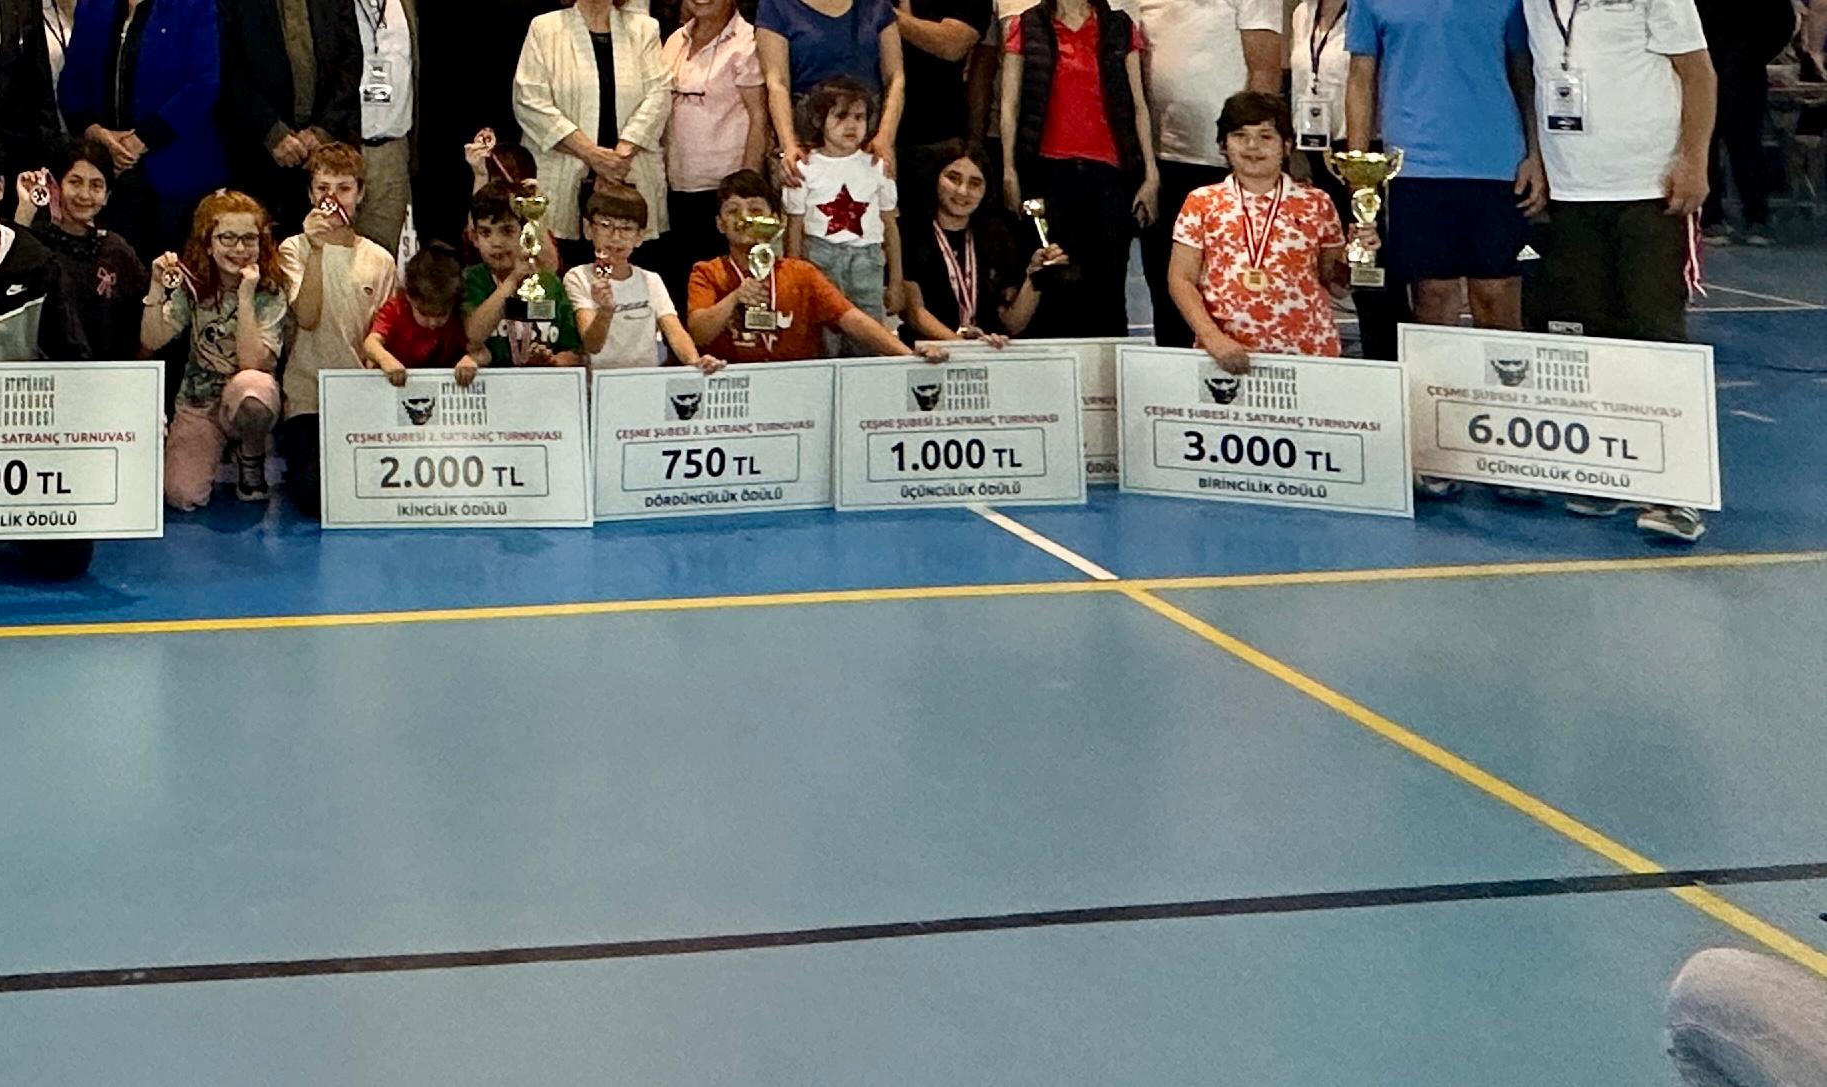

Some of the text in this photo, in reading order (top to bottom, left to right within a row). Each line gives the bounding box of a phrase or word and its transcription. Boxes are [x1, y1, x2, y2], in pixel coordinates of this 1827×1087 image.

[1427, 385, 1469, 399] ÇEŞME
[1246, 413, 1304, 427] SATRANÇ
[2, 433, 60, 445] SATRANÇ
[64, 432, 135, 443] TURNUVASI
[1468, 414, 1638, 460] 6.000 TL
[891, 439, 1022, 471] 1.000 TL
[1183, 430, 1341, 472] 3.000 TL
[380, 456, 524, 488] 2.000 TL
[662, 447, 761, 479] 750 TL
[1476, 459, 1630, 488] ÜÇÜNCÜLÜK ÖDÜLÜ
[37, 471, 70, 494] TL
[901, 481, 1021, 499] ÜÇÜNCÜLÜK ÖDÜLÜ
[1198, 476, 1327, 498] BİRİNCİLİK ÖDÜLÜ
[397, 501, 507, 516] İKİNCİLİK ÖDÜLÜ
[645, 488, 783, 508] DÖRDÜNCÜLÜK ÖDÜLÜ
[27, 511, 77, 527] ÖDÜLÜ
